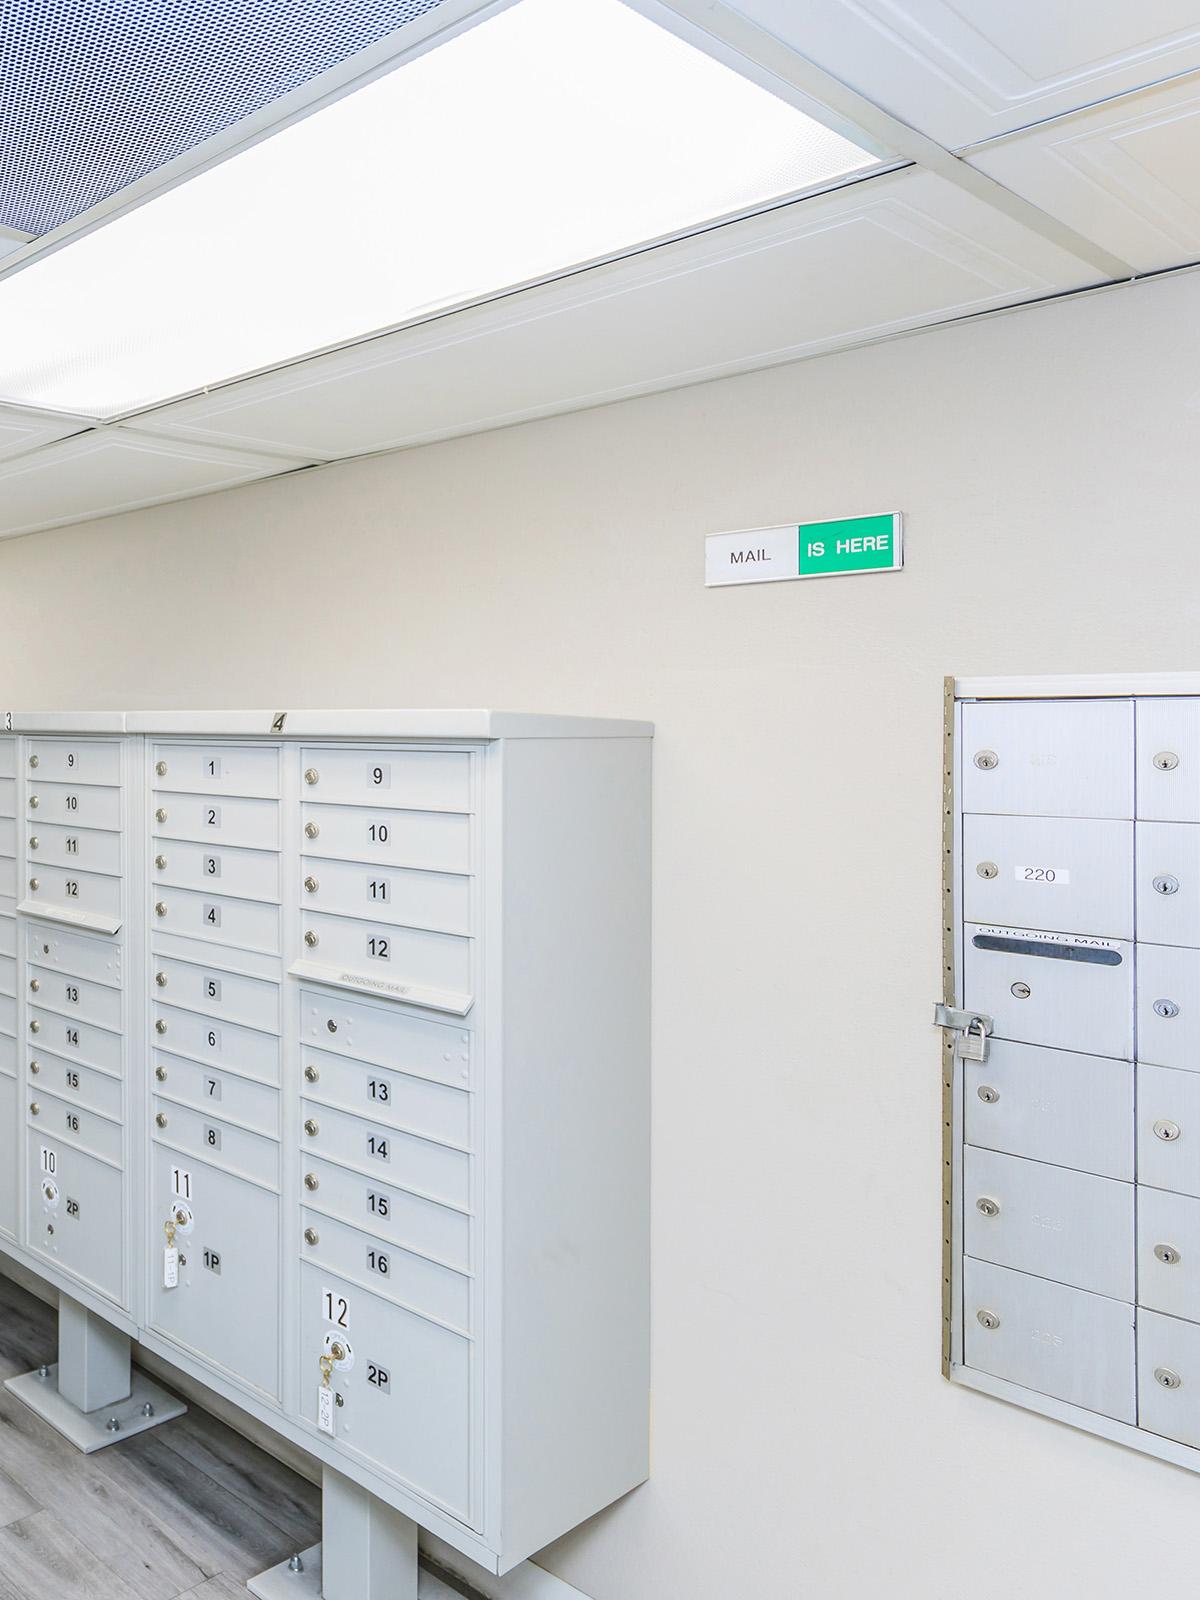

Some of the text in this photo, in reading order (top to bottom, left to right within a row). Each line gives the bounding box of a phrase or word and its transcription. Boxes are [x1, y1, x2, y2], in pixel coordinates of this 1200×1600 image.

[730, 535, 889, 564] MAIL IS HERE
[6, 713, 12, 730] 3
[273, 713, 286, 731] 4
[68, 754, 74, 767] 9
[209, 761, 214, 775] 1
[373, 768, 382, 784] 9
[66, 797, 77, 810] 10
[208, 810, 216, 824] 2
[368, 825, 388, 842] 10
[66, 839, 77, 852] 11
[208, 859, 215, 874] 3
[1024, 867, 1056, 882] 220
[66, 882, 77, 895] 12
[370, 882, 386, 899] 11
[208, 909, 216, 923] 4
[979, 928, 1068, 941] OUTGOING
[368, 939, 388, 957] 12
[66, 987, 78, 1001] 13
[208, 982, 216, 996] 5
[66, 1030, 78, 1044] 14
[208, 1032, 215, 1046] 6
[67, 1072, 78, 1087] 15
[209, 1080, 215, 1096] 7
[368, 1080, 388, 1100] 13
[67, 1115, 78, 1131] 16
[208, 1130, 215, 1145] 8
[368, 1137, 388, 1158] 14
[43, 1150, 55, 1173] 10
[174, 1169, 189, 1198] 11
[66, 1200, 78, 1214] 2P
[368, 1194, 388, 1215] 15
[204, 1251, 220, 1268] 1P
[368, 1251, 388, 1273] 16
[326, 1293, 348, 1327] 12
[368, 1365, 388, 1386] 2P
